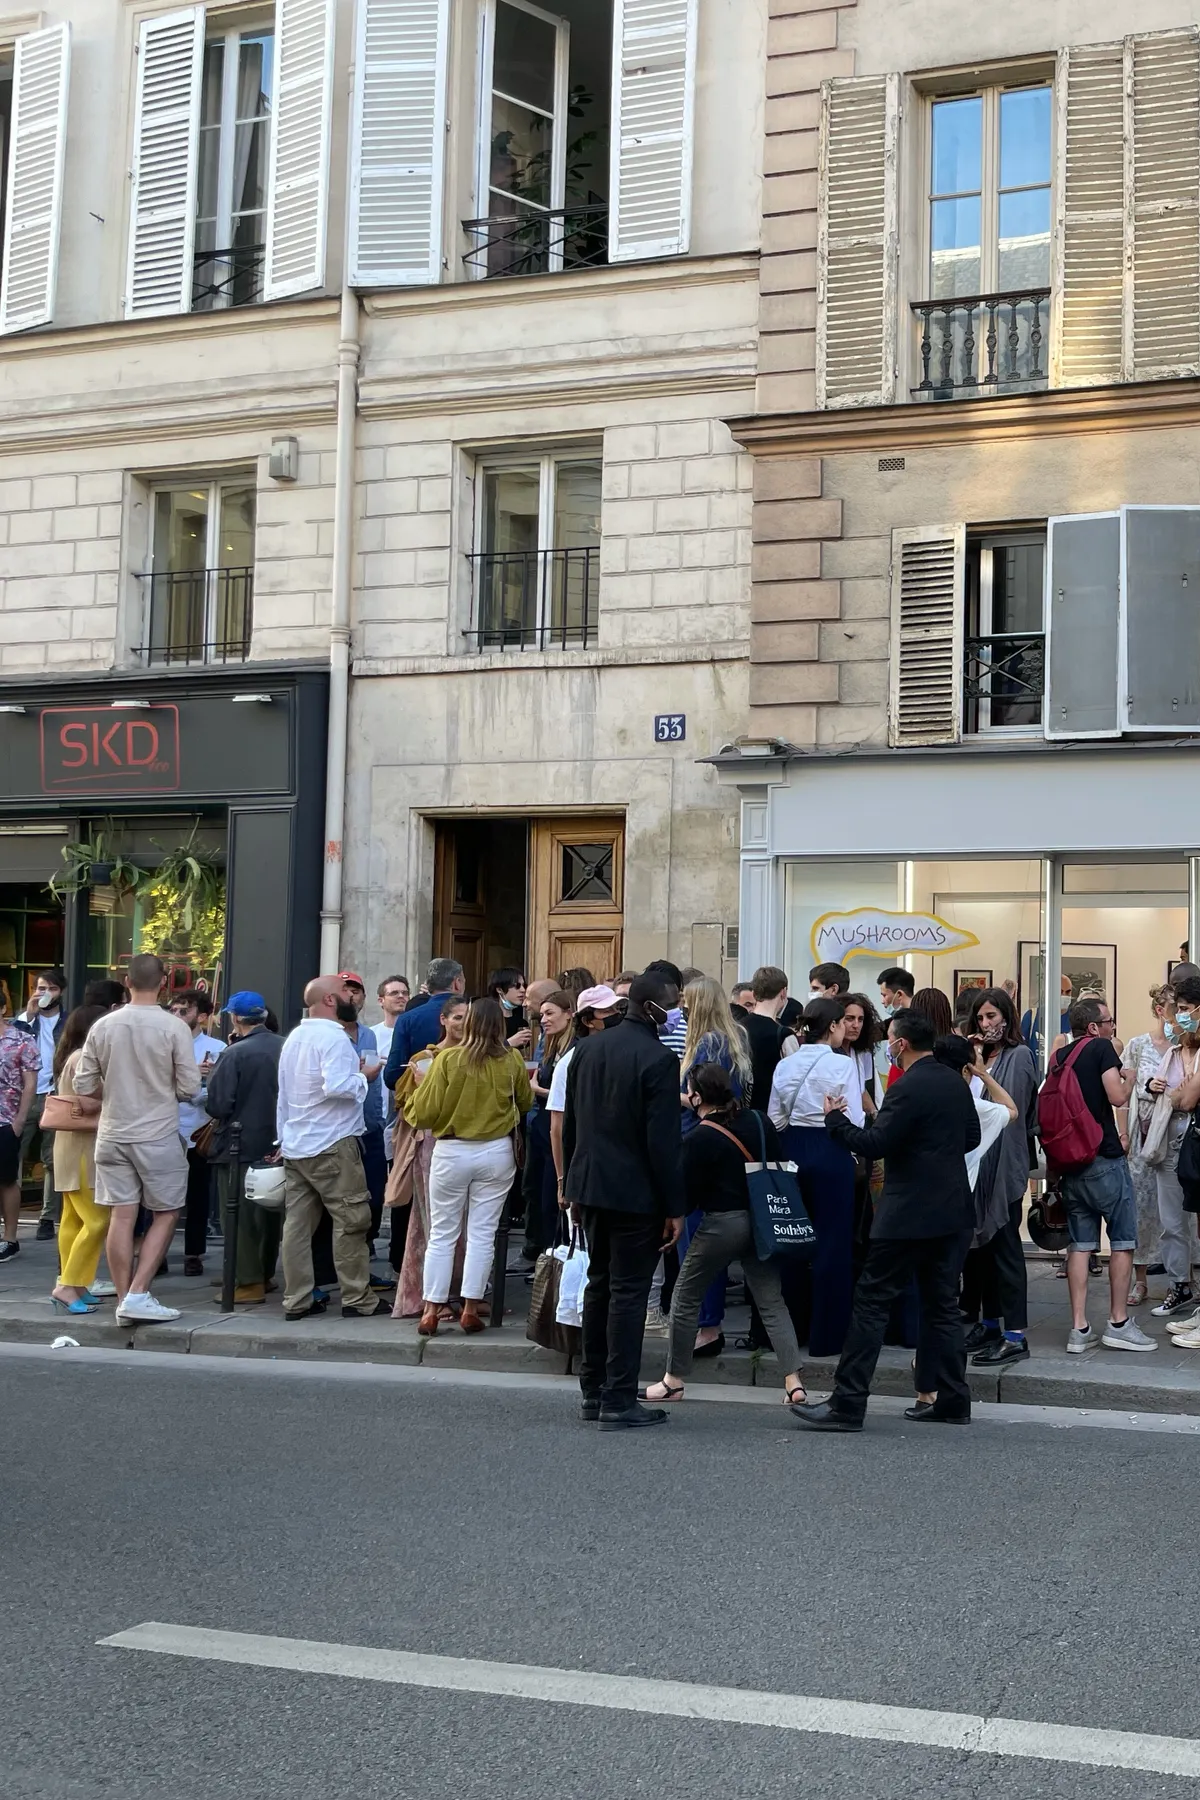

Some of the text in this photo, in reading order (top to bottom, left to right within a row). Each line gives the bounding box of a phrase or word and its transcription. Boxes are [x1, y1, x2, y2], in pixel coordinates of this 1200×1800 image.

[658, 716, 683, 740] 53
[60, 720, 159, 767] SKD
[818, 924, 946, 946] MUSHROOMS
[773, 1223, 814, 1237] Sotheby's
